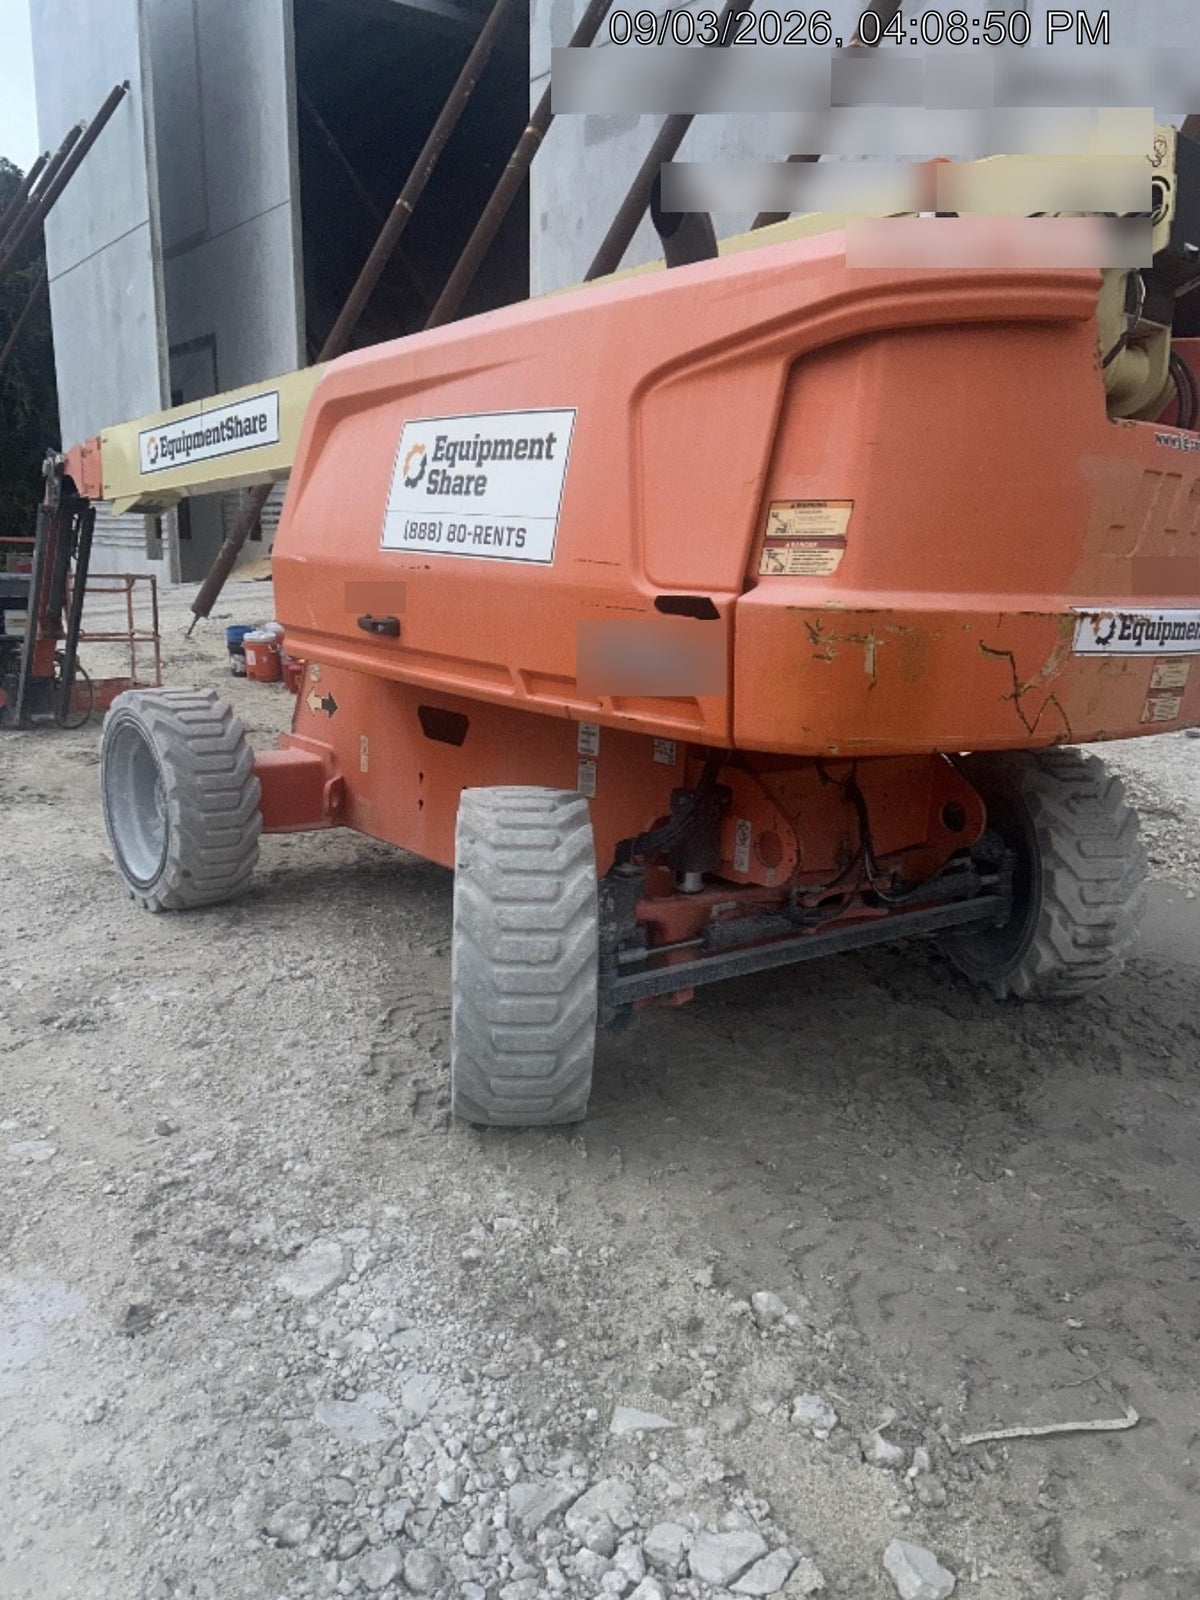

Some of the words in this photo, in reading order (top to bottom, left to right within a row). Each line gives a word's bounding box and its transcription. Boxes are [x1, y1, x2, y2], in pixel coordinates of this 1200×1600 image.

[159, 413, 268, 460] EquipmentShare
[431, 432, 557, 468] Equipment
[426, 469, 488, 497] Share
[403, 519, 443, 543] (888)
[446, 523, 527, 548] 80-RENTS
